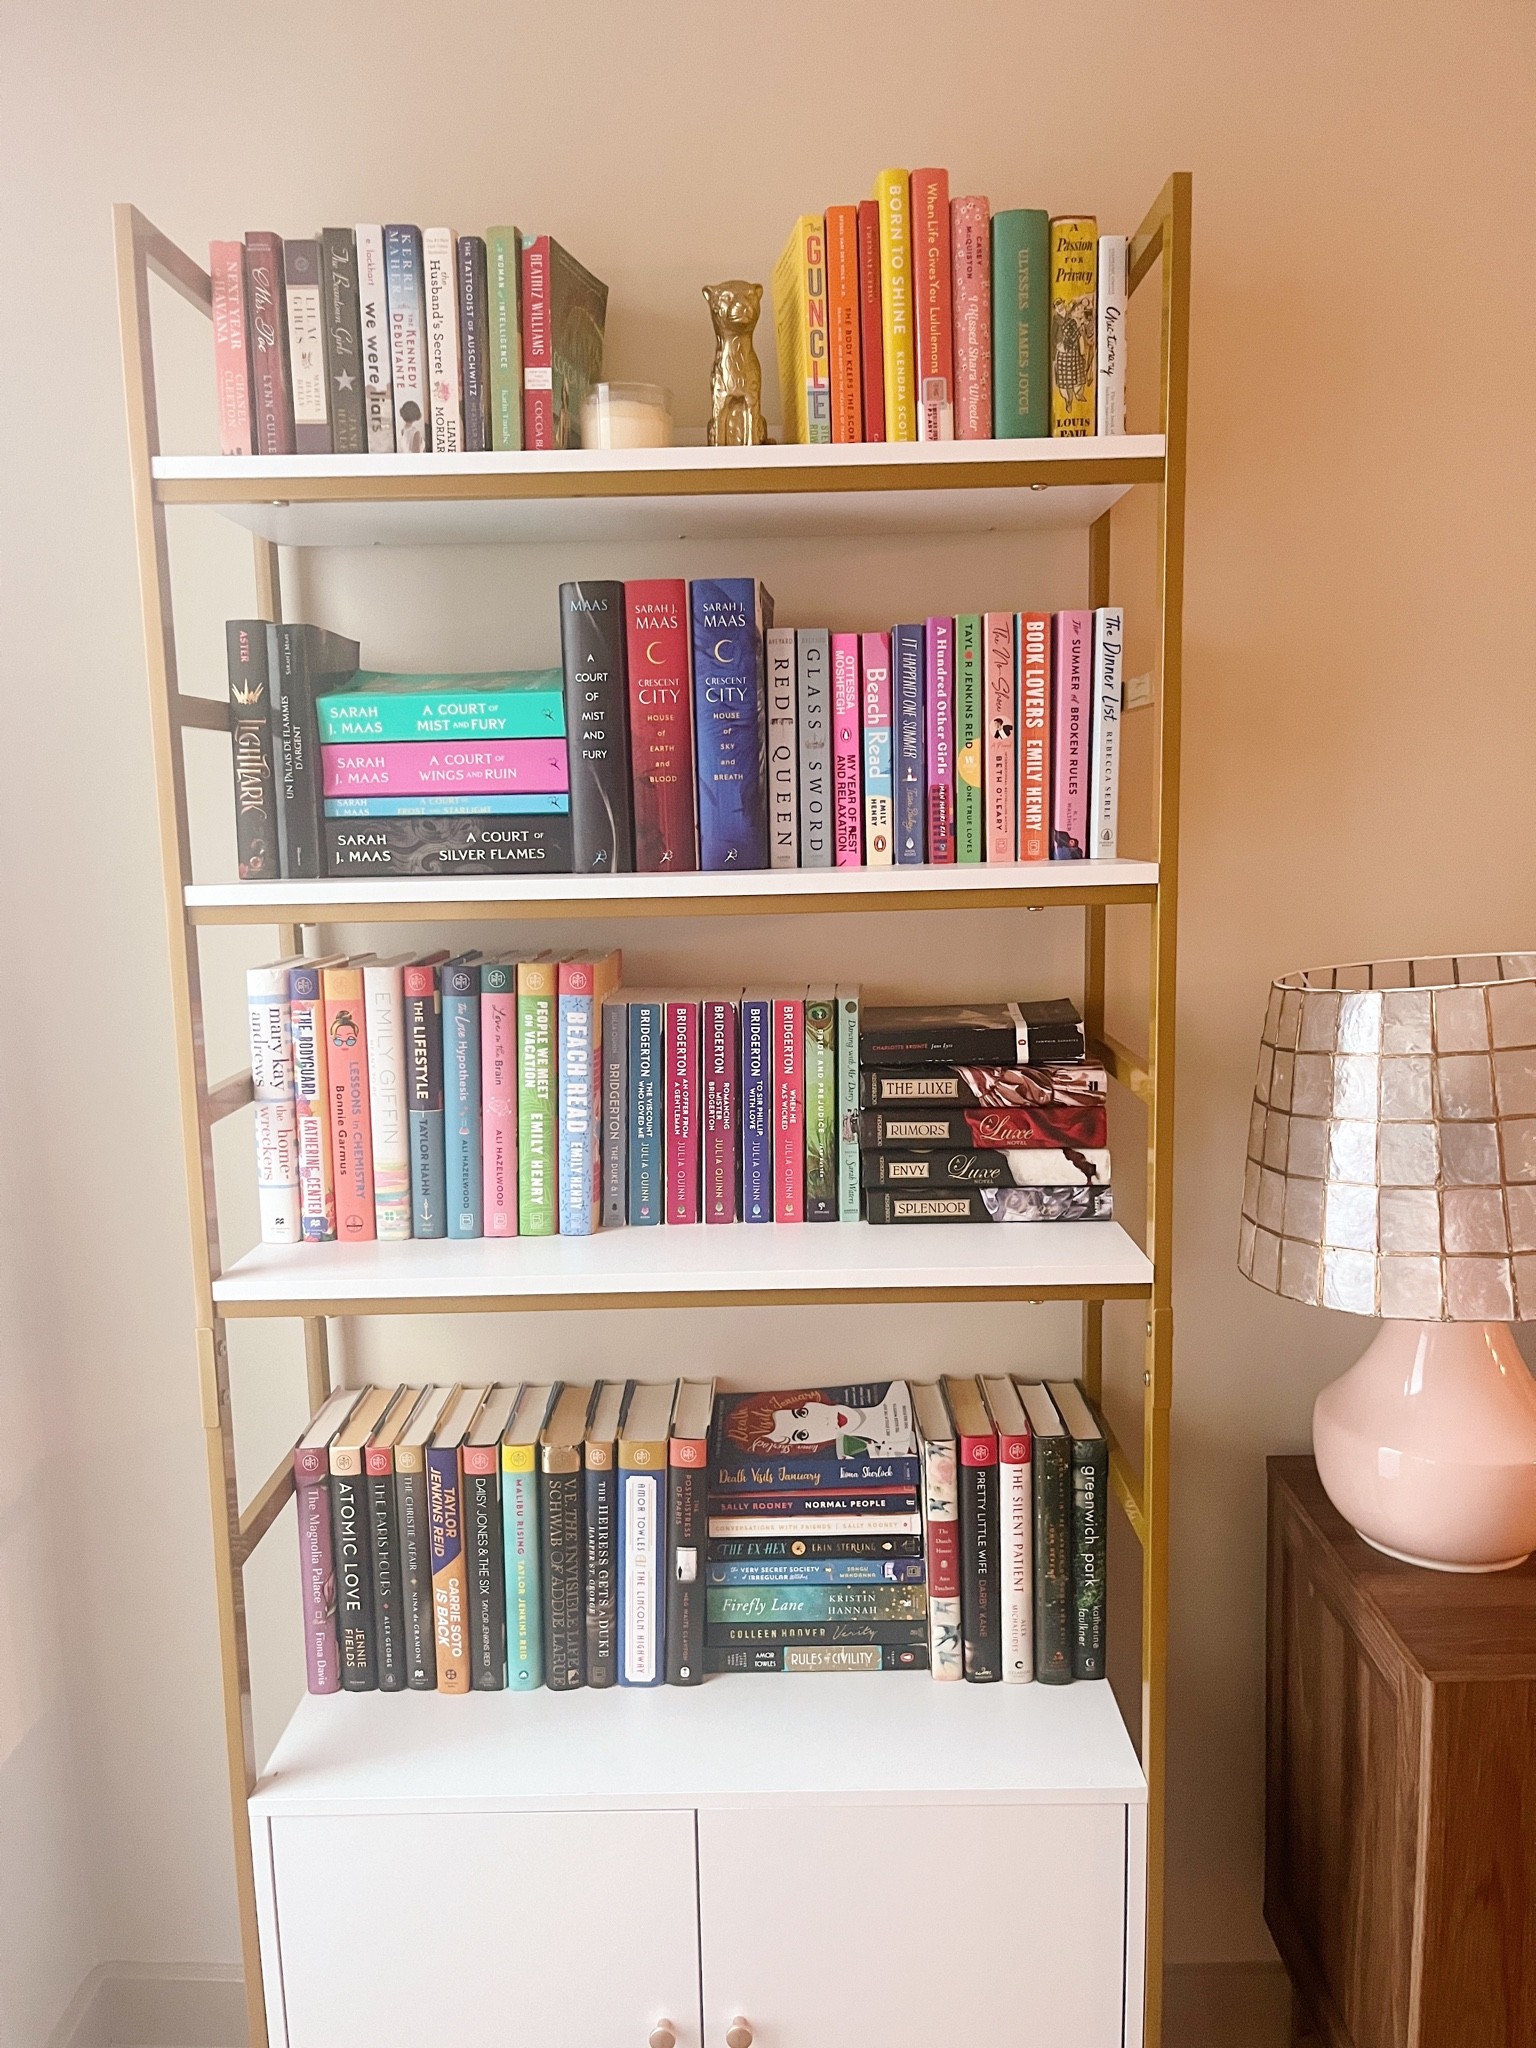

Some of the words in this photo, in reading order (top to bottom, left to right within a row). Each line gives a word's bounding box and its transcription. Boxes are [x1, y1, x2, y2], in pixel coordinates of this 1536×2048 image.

[888, 185, 903, 240] BORN
[926, 183, 938, 221] When
[806, 223, 821, 232] The
[927, 223, 938, 244] Life
[1056, 237, 1093, 252] Passion
[389, 230, 400, 294] MAHER
[401, 234, 413, 292] KERRI
[530, 254, 543, 299] BEATRIZ
[890, 248, 904, 268] TO
[928, 248, 939, 280] Gives
[1055, 268, 1093, 284] Privacy
[227, 262, 239, 302] NEXT
[252, 267, 272, 315] Mrs.
[429, 260, 444, 329] Husband's
[465, 260, 474, 318] TATTOOIST
[928, 280, 940, 303] You
[1018, 249, 1029, 310] ULYSSES
[365, 302, 376, 328] we
[891, 277, 906, 334] SHINE
[229, 310, 242, 349] YEAR
[256, 318, 274, 352] Poe
[468, 321, 474, 330] OF
[531, 302, 544, 356] WILLIAMS
[806, 235, 825, 419] GUNCLE
[928, 306, 941, 374] Lululemons
[1018, 322, 1029, 367] JAMES
[368, 336, 380, 383] were
[393, 314, 405, 389] DEBUTANTE
[434, 333, 443, 374] Secret
[467, 334, 477, 396] AUSCHWITZ
[895, 351, 906, 401] KENDRA
[1018, 371, 1029, 416] JOYCE
[370, 391, 385, 432] liars
[897, 406, 908, 442] SCOTT
[1056, 418, 1090, 428] LOUIS
[635, 604, 668, 614] SARAH
[671, 604, 678, 614] J.
[636, 616, 678, 629] MAAS
[239, 631, 249, 663] ASTER
[937, 626, 946, 635] A
[1026, 621, 1044, 664] BOOK
[575, 672, 608, 682] COURT
[587, 654, 595, 662] A
[936, 640, 947, 697] Hundred
[585, 692, 599, 702] OF
[638, 678, 680, 687] CRESCENT
[638, 688, 681, 705] CITY
[774, 658, 790, 710] RED
[807, 649, 822, 729] GLASS
[836, 650, 845, 715] MOSHFEGH
[846, 656, 854, 709] OTTESSA
[867, 668, 888, 725] Beach
[1025, 670, 1044, 729] LOVERS
[329, 723, 337, 736] J.
[341, 721, 383, 734] MAAS
[330, 706, 378, 718] SARAH
[417, 720, 450, 731] MIST
[453, 720, 470, 728] AND
[471, 719, 507, 730] FURY
[423, 704, 433, 716] A
[438, 703, 486, 715] COURT
[581, 711, 604, 721] MIST
[937, 701, 947, 741] Other
[583, 730, 605, 740] AND
[657, 729, 666, 737] of
[234, 718, 271, 820] LIGHTLARK
[582, 750, 607, 759] FURY
[868, 731, 889, 779] Read
[937, 742, 948, 775] Girls
[1026, 739, 1043, 782] EMILY
[650, 775, 678, 783] BLOOD
[772, 746, 792, 846] QUEEN
[809, 761, 824, 851] SWORD
[1025, 786, 1042, 832] HENRY
[337, 834, 387, 846] SARAH
[439, 849, 486, 861] SILVER
[490, 848, 545, 860] FLAMES
[466, 832, 477, 843] A
[481, 831, 529, 842] COURT
[335, 852, 343, 864] J.
[349, 850, 391, 862] MAAS
[299, 1011, 311, 1035] THE
[412, 1001, 424, 1022] THE
[566, 1012, 587, 1077] BEACH
[640, 1009, 651, 1077] BRIDGERTON
[676, 1008, 686, 1076] BRIDGERTON
[714, 1005, 724, 1075] BRIDGERTON
[750, 1008, 761, 1077] BRIDGERTON
[783, 1006, 794, 1075] BRIDGERTON
[299, 1038, 315, 1095] BODYGUARD
[413, 1026, 429, 1100] LIFESTYLE
[335, 1085, 345, 1127] Bonnie
[886, 1083, 913, 1095] THE
[918, 1081, 952, 1094] LUXE
[567, 1083, 587, 1133] READ
[890, 1124, 946, 1136] RUMORS
[337, 1130, 348, 1176] Garmus
[571, 1142, 583, 1172] EMILY
[893, 1165, 925, 1176] ENVY
[570, 1173, 583, 1210] HENRY
[898, 1202, 966, 1214] SPLENDOR
[430, 1468, 443, 1526] JENKINS
[976, 1471, 985, 1509] PRETTY
[1012, 1468, 1022, 1490] THE
[339, 1483, 357, 1556] ATOMIC
[444, 1488, 457, 1538] TAYLOR
[752, 1502, 793, 1510] ROONEY
[804, 1500, 847, 1508] NORMAL
[850, 1499, 886, 1507] PEOPLE
[1012, 1497, 1024, 1537] SILENT
[1080, 1466, 1099, 1545] greenwich
[432, 1530, 445, 1557] REID
[977, 1511, 986, 1547] LITTLE
[977, 1551, 987, 1575] WIFE
[1013, 1544, 1024, 1593] PATIENT
[1081, 1553, 1099, 1587] park
[344, 1564, 360, 1611] LOVE
[436, 1589, 447, 1603] IS
[449, 1578, 460, 1623] CARRIE
[722, 1597, 766, 1614] Firefly
[772, 1596, 804, 1612] Lane
[828, 1594, 876, 1603] KRISTIN
[979, 1579, 987, 1608] DARBY
[436, 1608, 450, 1646] BACK
[828, 1606, 878, 1615] HANNAH
[978, 1611, 987, 1637] KANE
[344, 1628, 355, 1667] FIELDS
[356, 1627, 366, 1668] JENNIE
[451, 1625, 462, 1657] SOTO
[520, 1641, 528, 1661] REID
